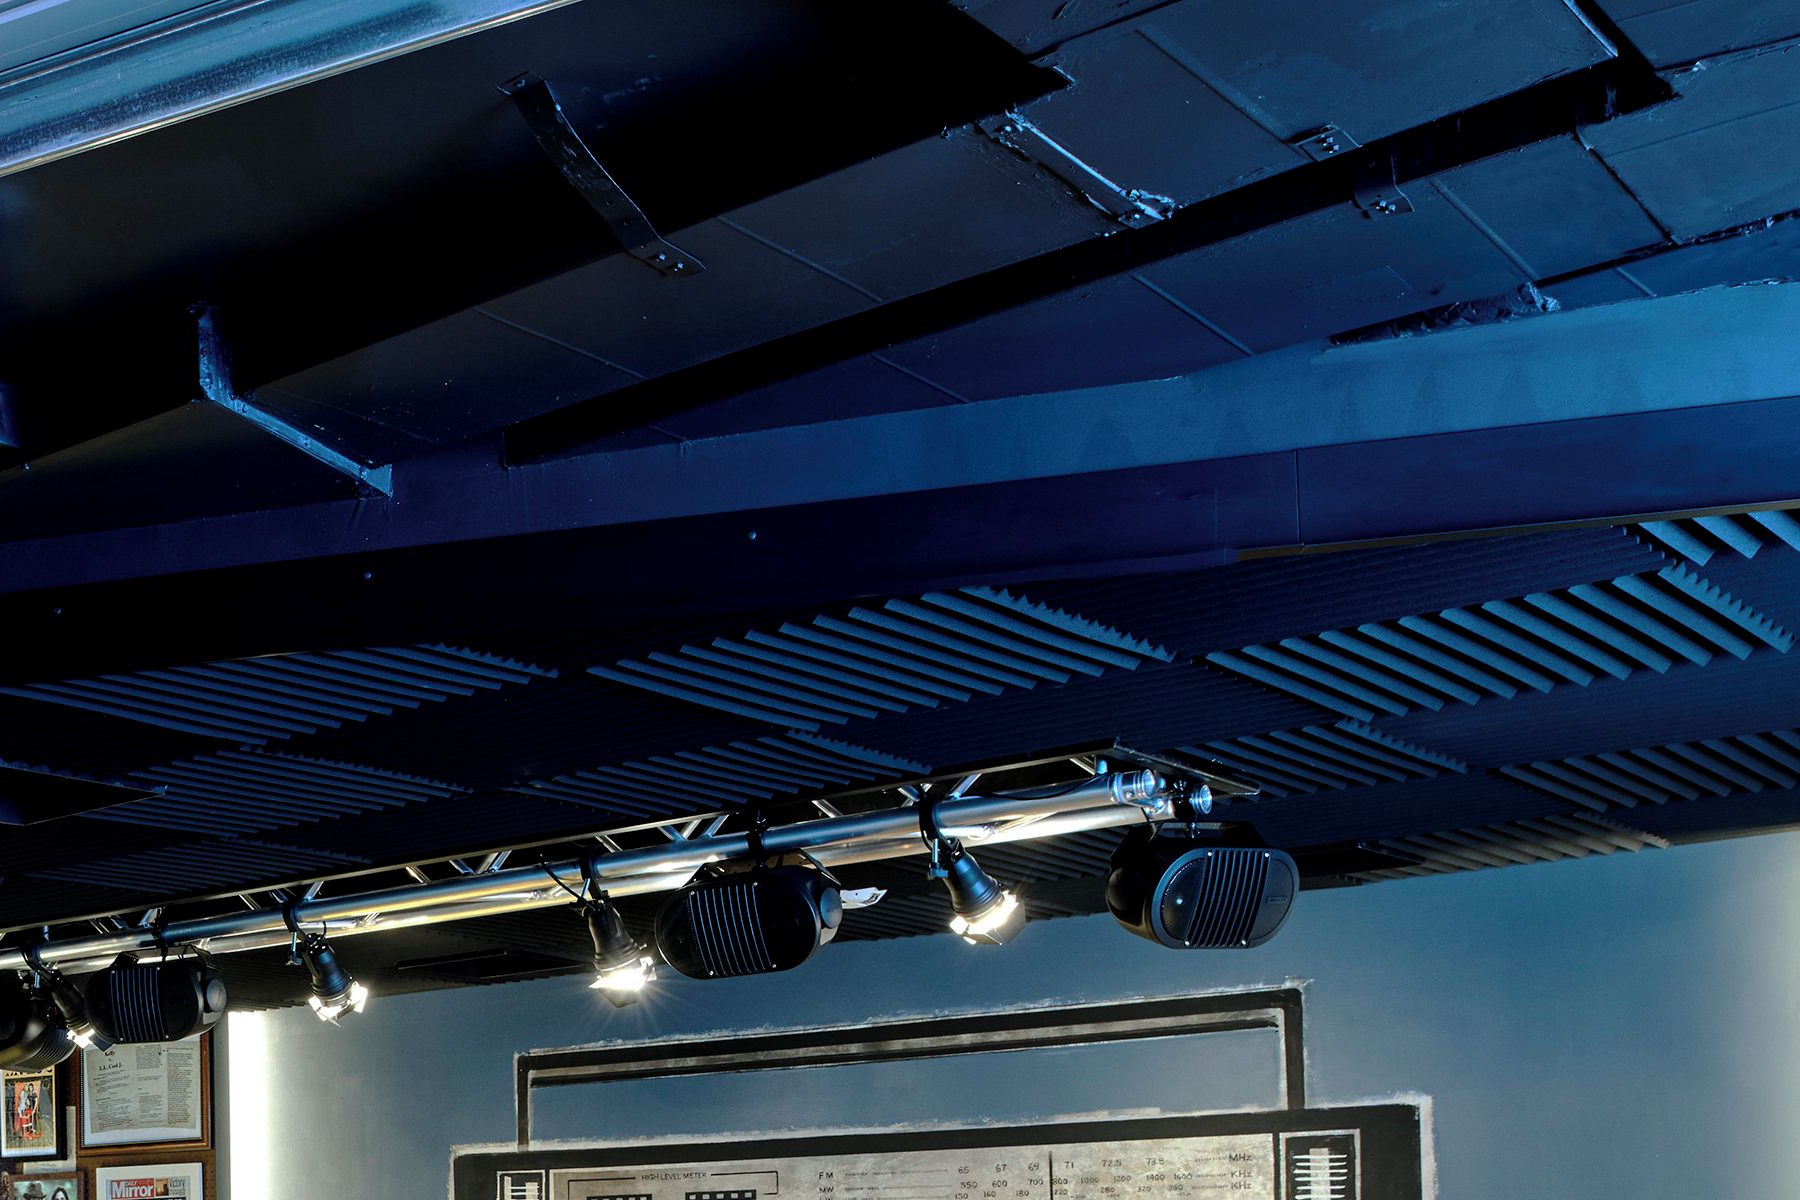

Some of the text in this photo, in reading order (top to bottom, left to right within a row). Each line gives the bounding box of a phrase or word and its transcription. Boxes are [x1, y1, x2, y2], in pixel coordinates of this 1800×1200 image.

[958, 1166, 969, 1174] 65
[996, 1163, 1007, 1173] 67
[1028, 1162, 1039, 1171] 69
[1064, 1161, 1074, 1169] 71
[1102, 1159, 1122, 1167] 72.5
[1229, 1153, 1252, 1162] MHz
[660, 1173, 682, 1181] LEVEL
[960, 1181, 977, 1189] 550
[992, 1180, 1008, 1188] 600
[1028, 1178, 1044, 1186] 700
[1113, 1175, 1131, 1183] 1200
[112, 1181, 153, 1198] Mirror
[1231, 1181, 1252, 1190] KHz
